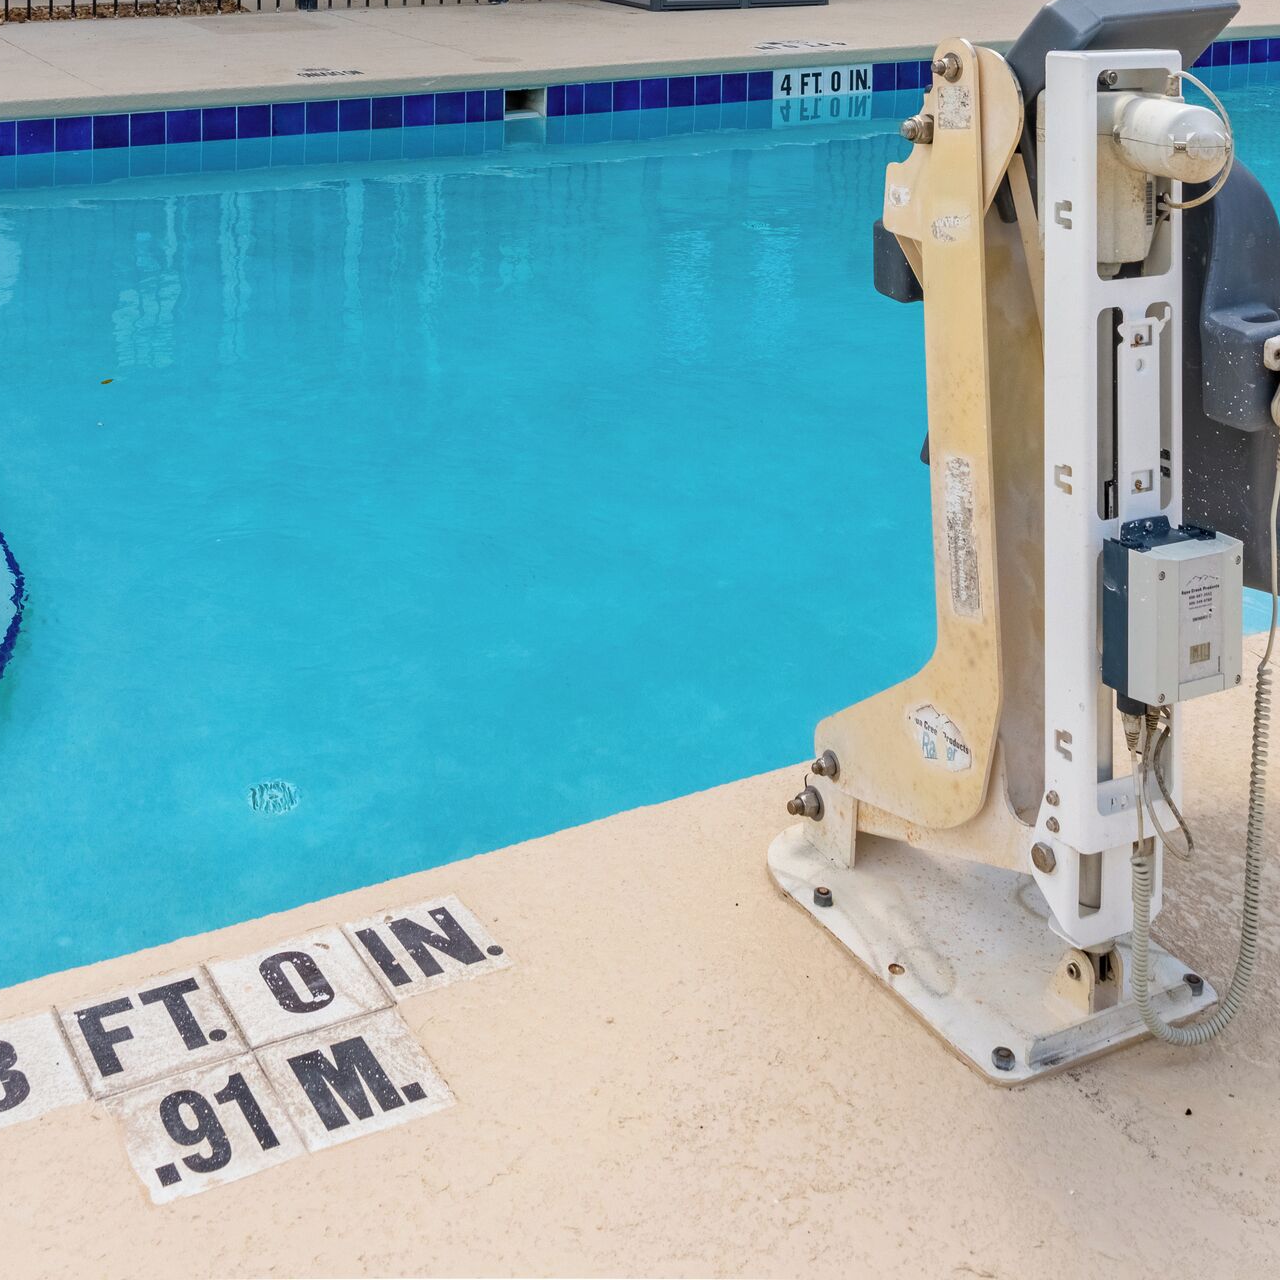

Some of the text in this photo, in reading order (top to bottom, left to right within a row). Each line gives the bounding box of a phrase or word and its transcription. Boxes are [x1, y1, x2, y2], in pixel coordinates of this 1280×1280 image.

[780, 69, 871, 96] 4 FT. 0 IN.
[72, 977, 227, 1077] FT.
[355, 906, 505, 987] IN.
[155, 1036, 428, 1187] .91 M.
